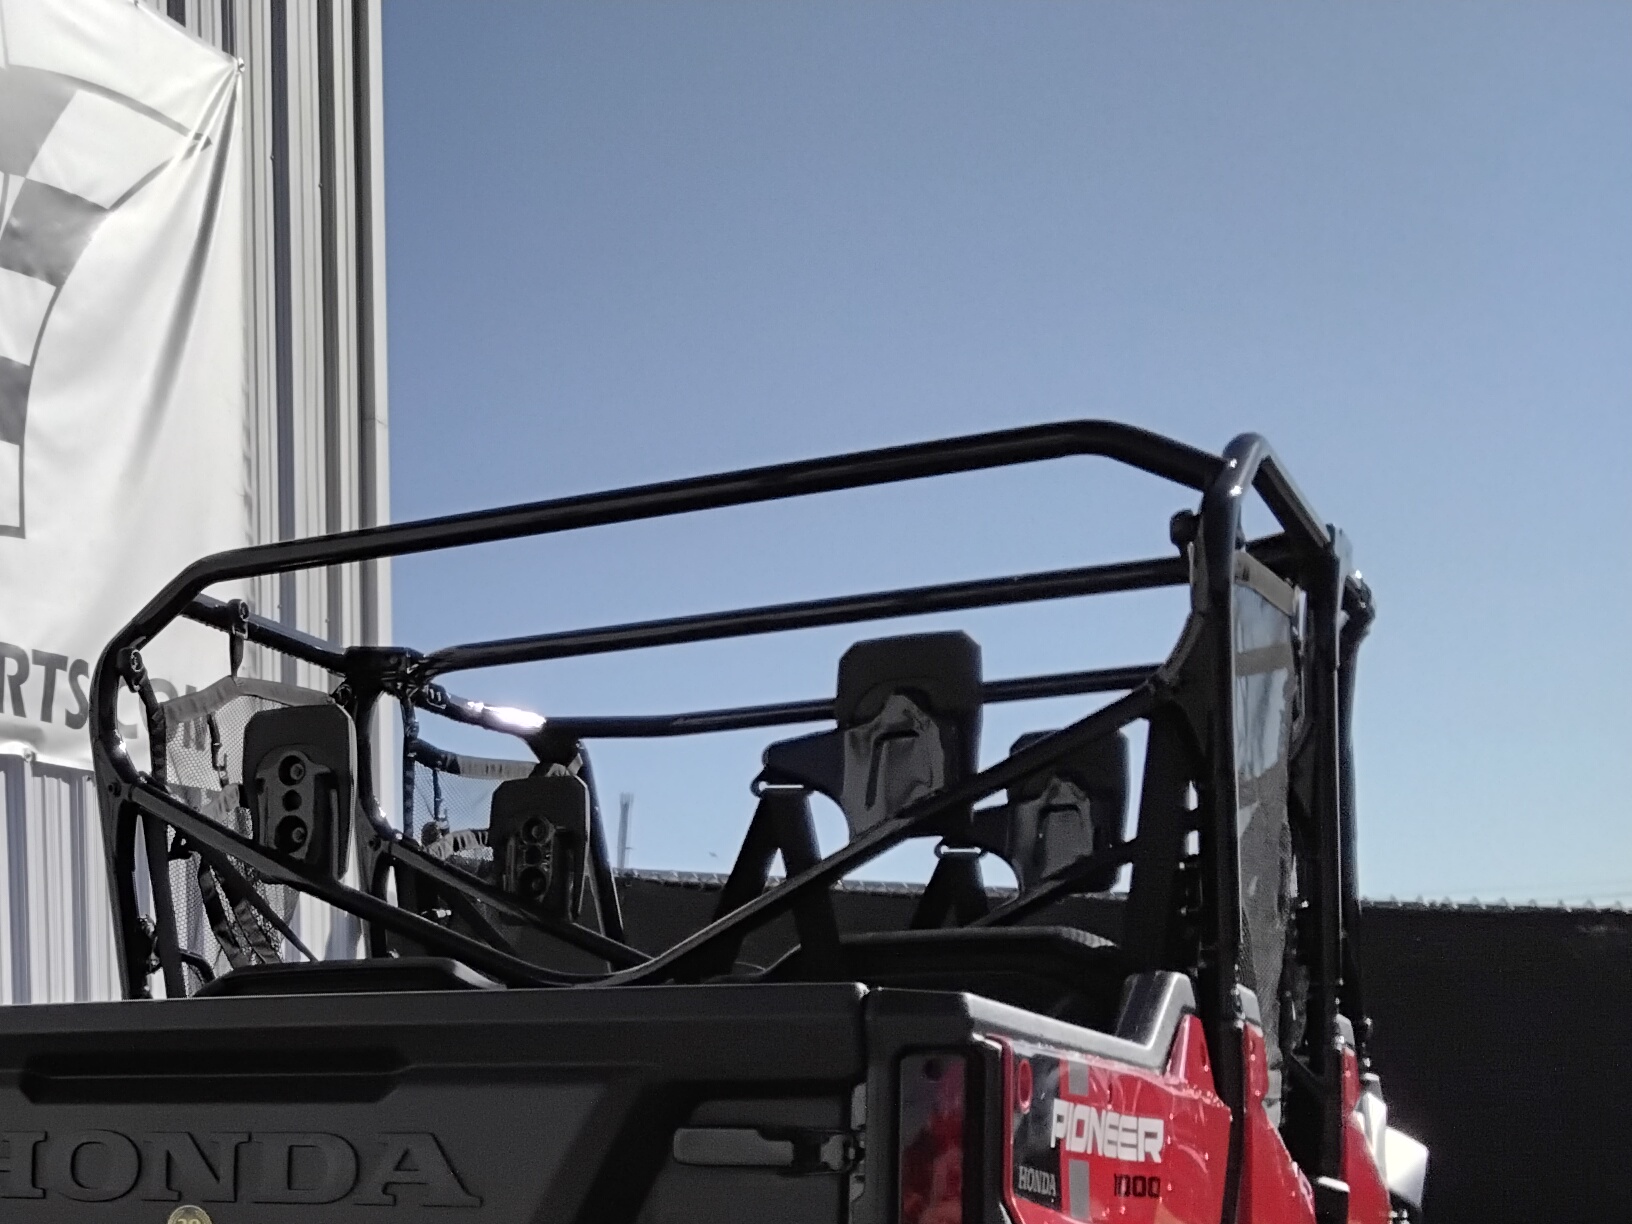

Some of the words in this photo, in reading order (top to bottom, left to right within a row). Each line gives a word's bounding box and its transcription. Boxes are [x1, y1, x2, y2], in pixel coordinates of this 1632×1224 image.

[1049, 1097, 1165, 1164] PIONEER
[1017, 1164, 1057, 1197] HONDA
[1113, 1172, 1161, 1198] 1000
